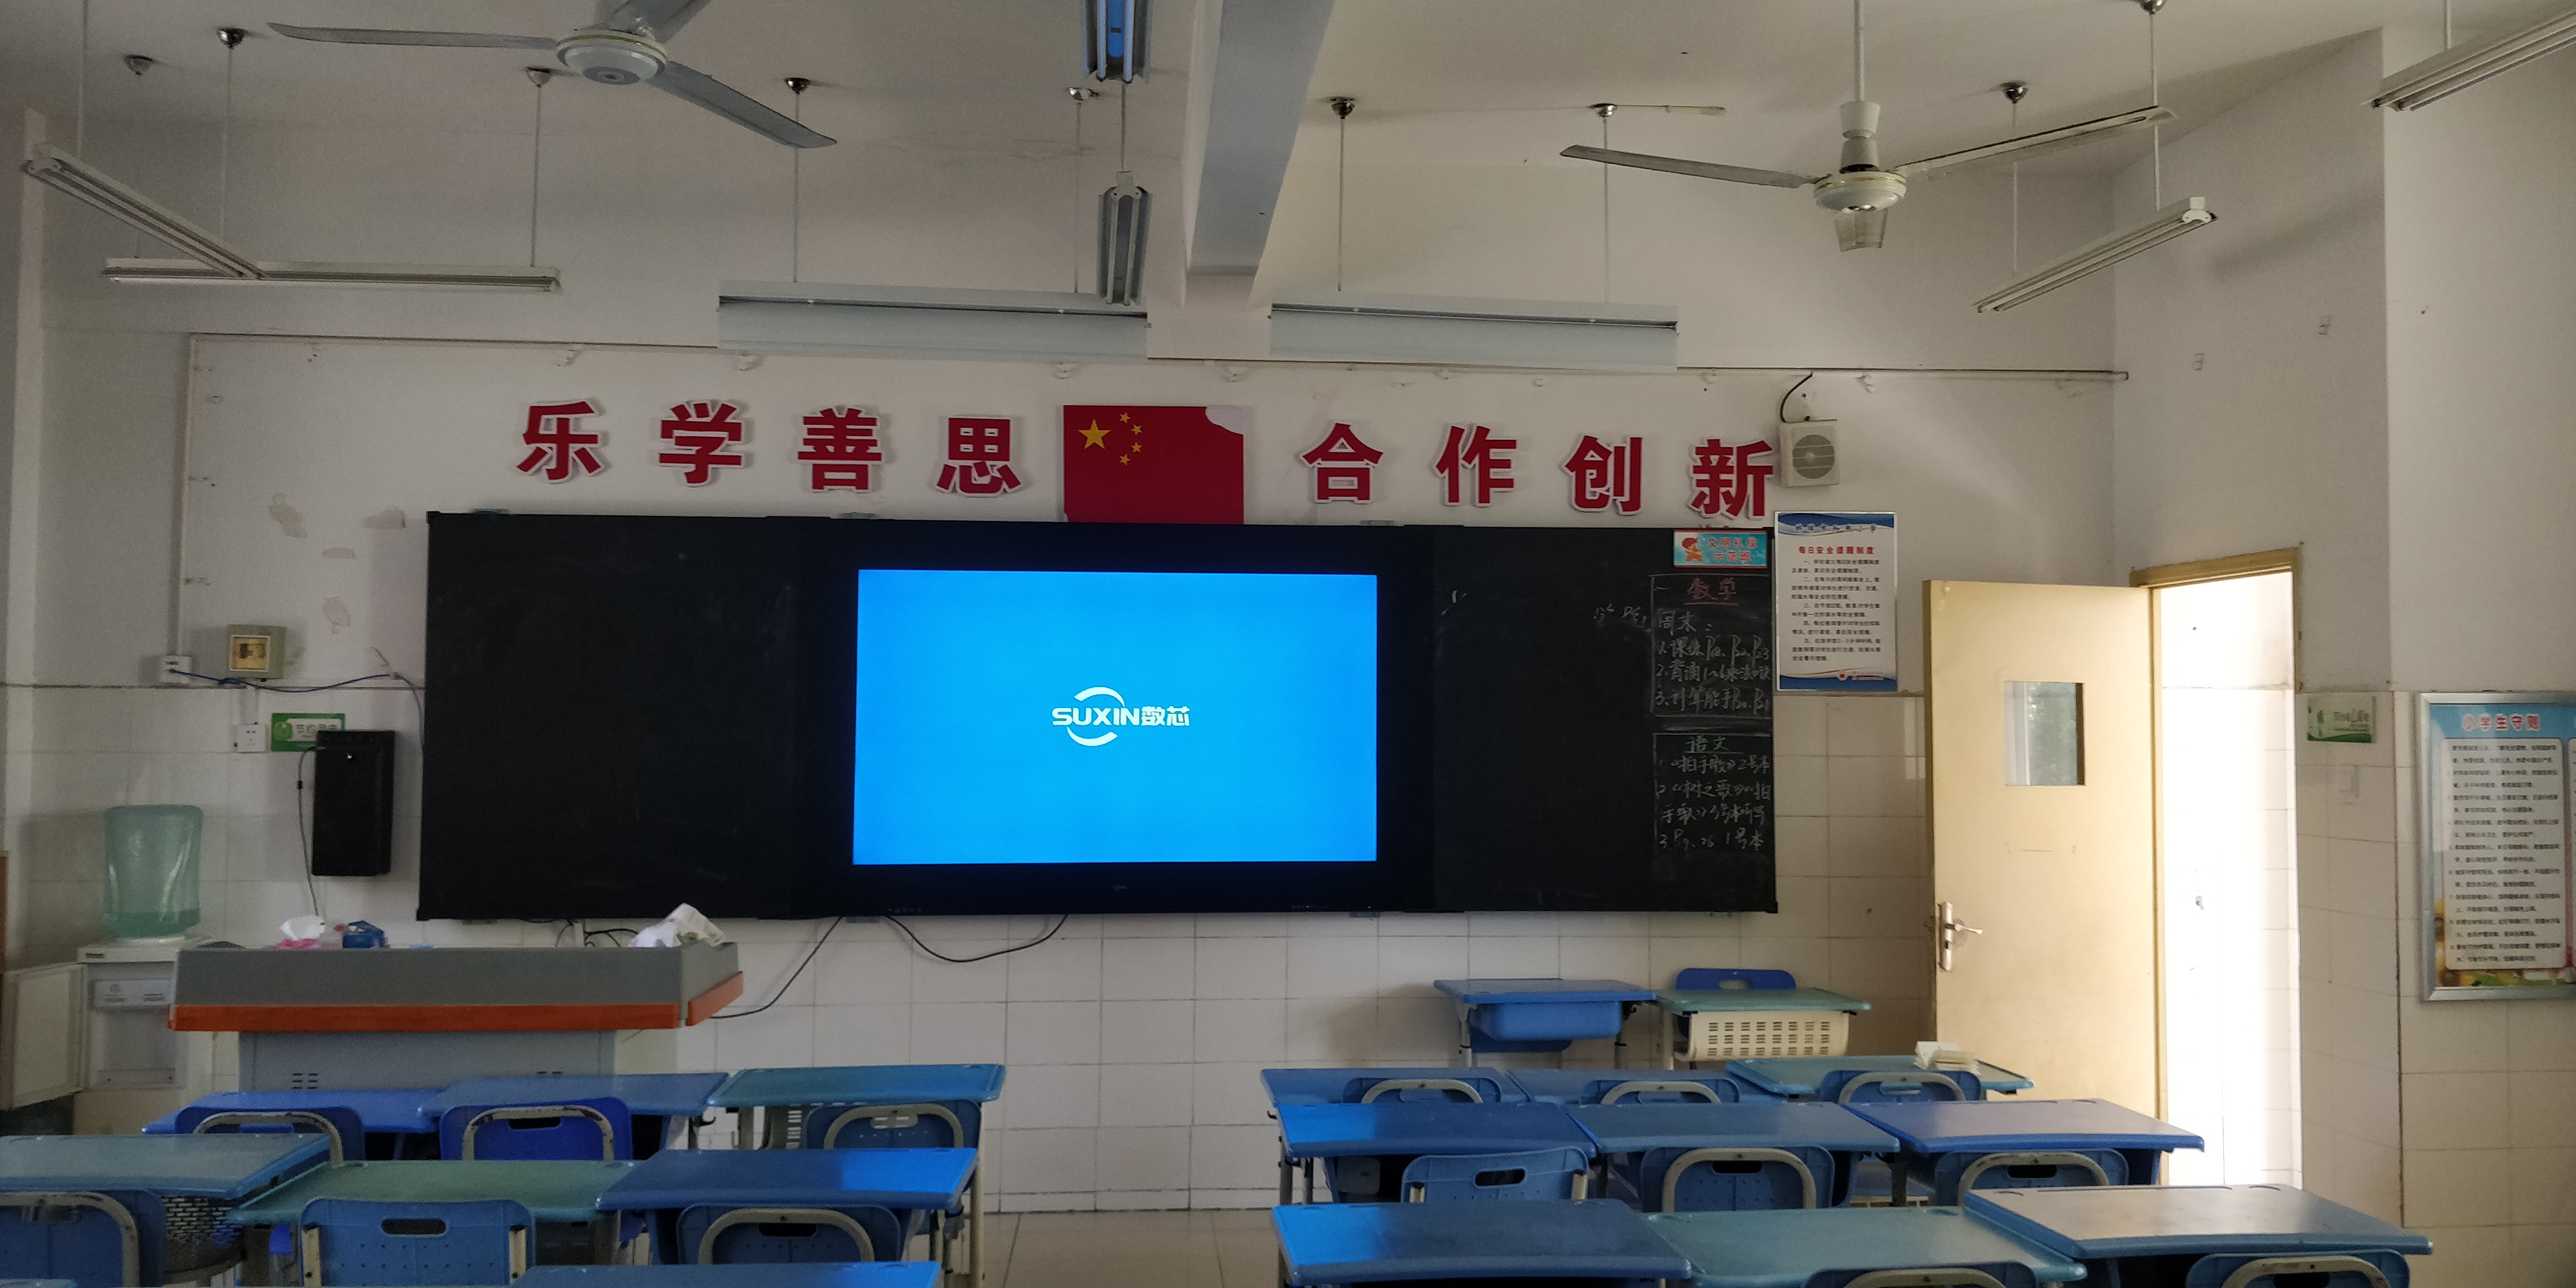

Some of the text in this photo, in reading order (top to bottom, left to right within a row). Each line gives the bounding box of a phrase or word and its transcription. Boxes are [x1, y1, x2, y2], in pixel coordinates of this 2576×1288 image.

[515, 399, 1022, 497] 乐学善思
[1301, 422, 1774, 518] 合作创新
[1798, 546, 1874, 555] 每日安全提醒制度
[1686, 577, 1737, 600] 数学
[2461, 713, 2540, 731] 小学生守则
[1685, 735, 1730, 752] 语文
